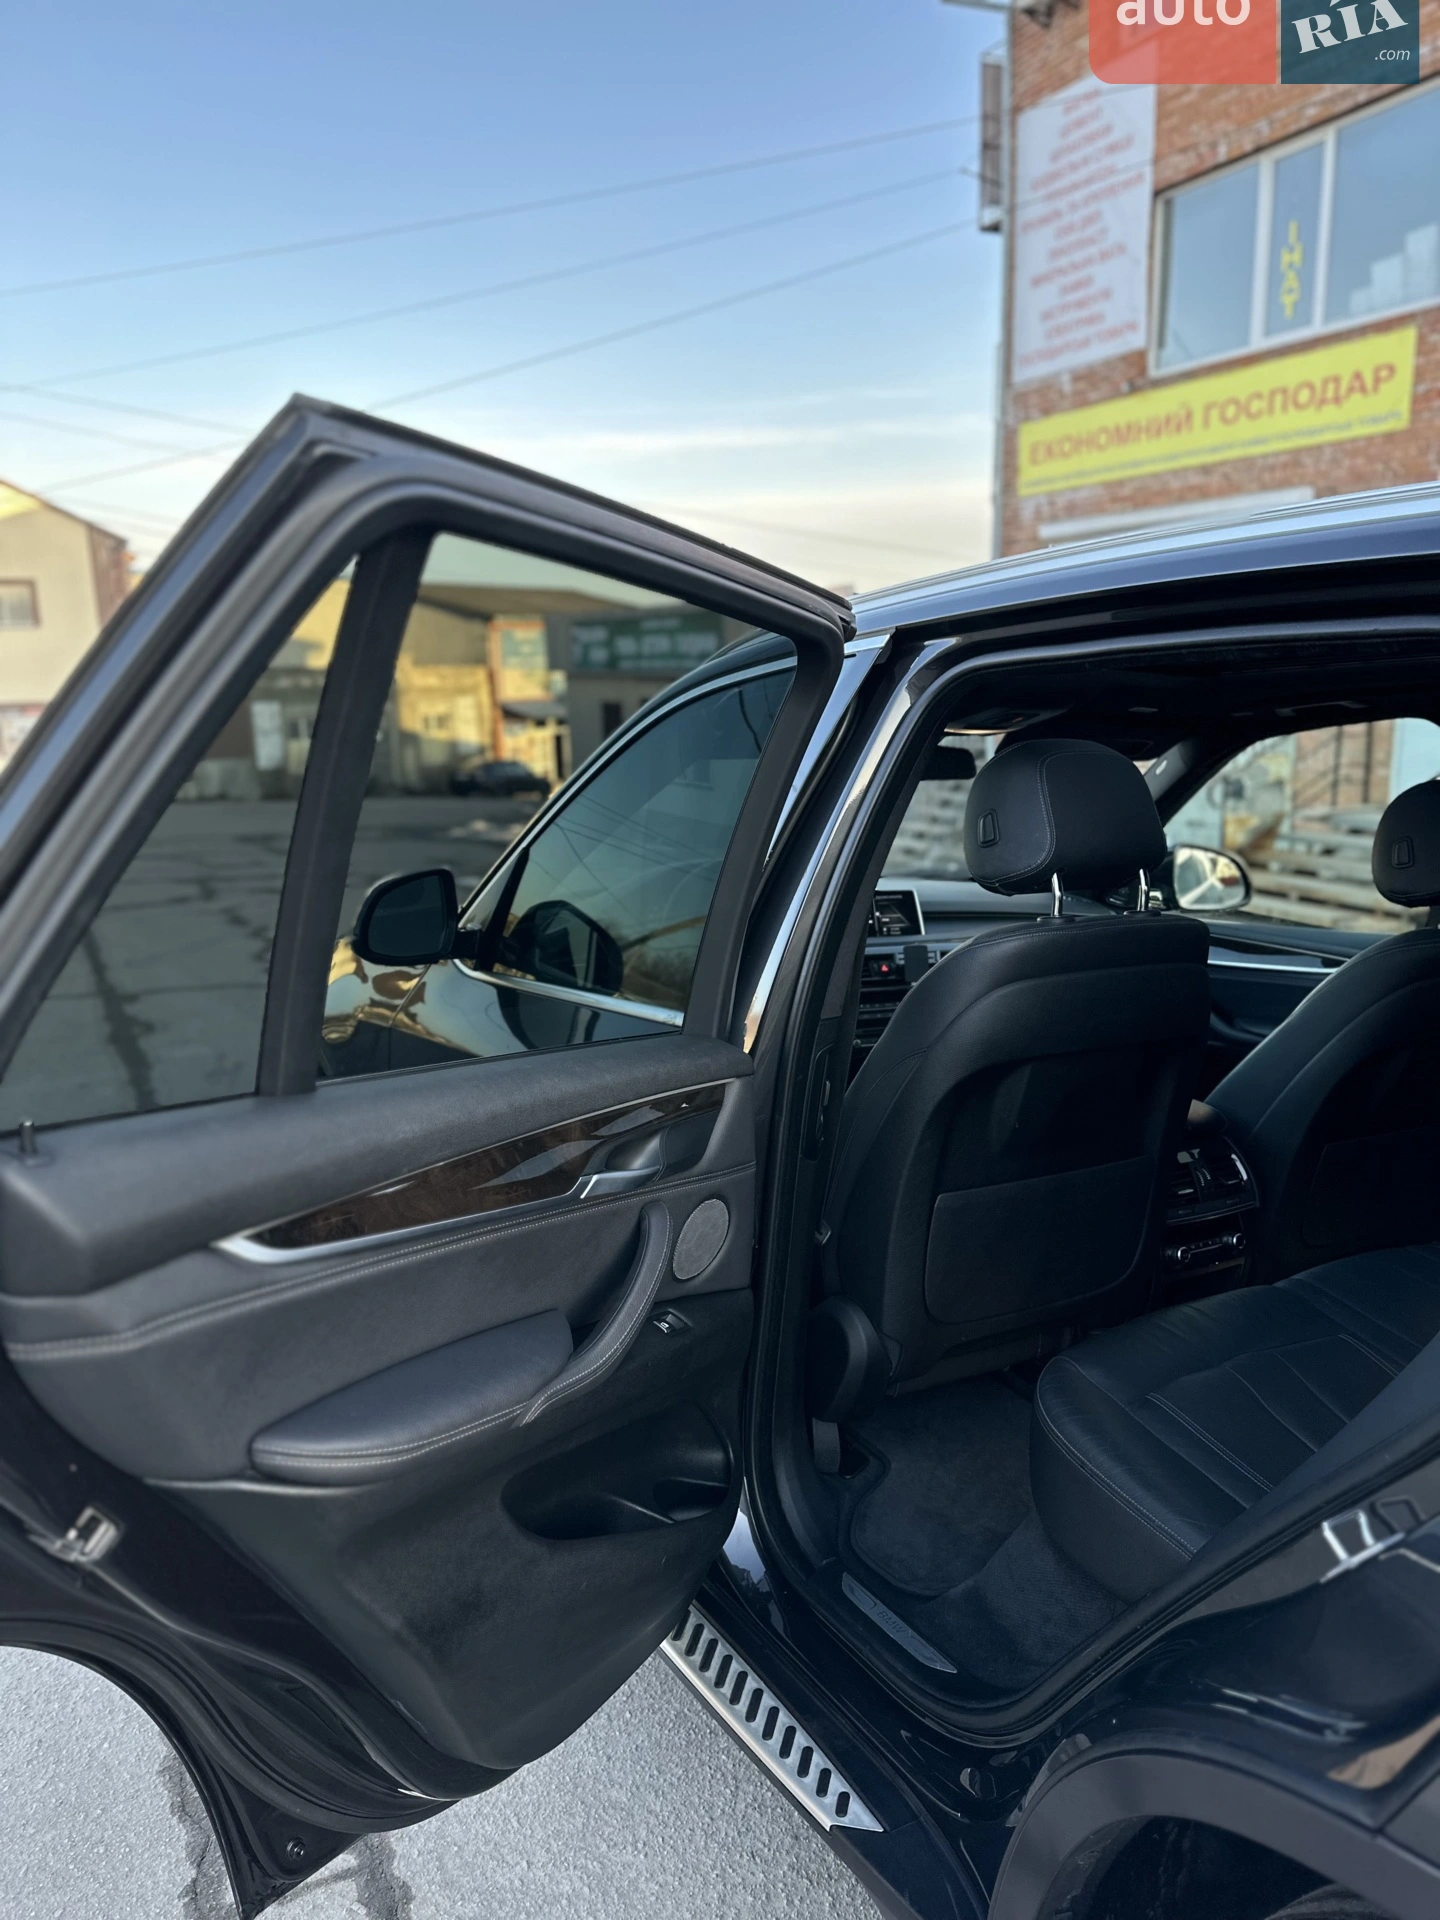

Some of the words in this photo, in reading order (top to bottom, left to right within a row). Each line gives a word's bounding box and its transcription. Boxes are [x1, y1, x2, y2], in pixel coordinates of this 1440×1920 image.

[1028, 402, 1194, 466] ЕКОНОМНИЙ
[1201, 362, 1398, 431] ГОСПОДАР
[877, 1611, 907, 1632] BMW
